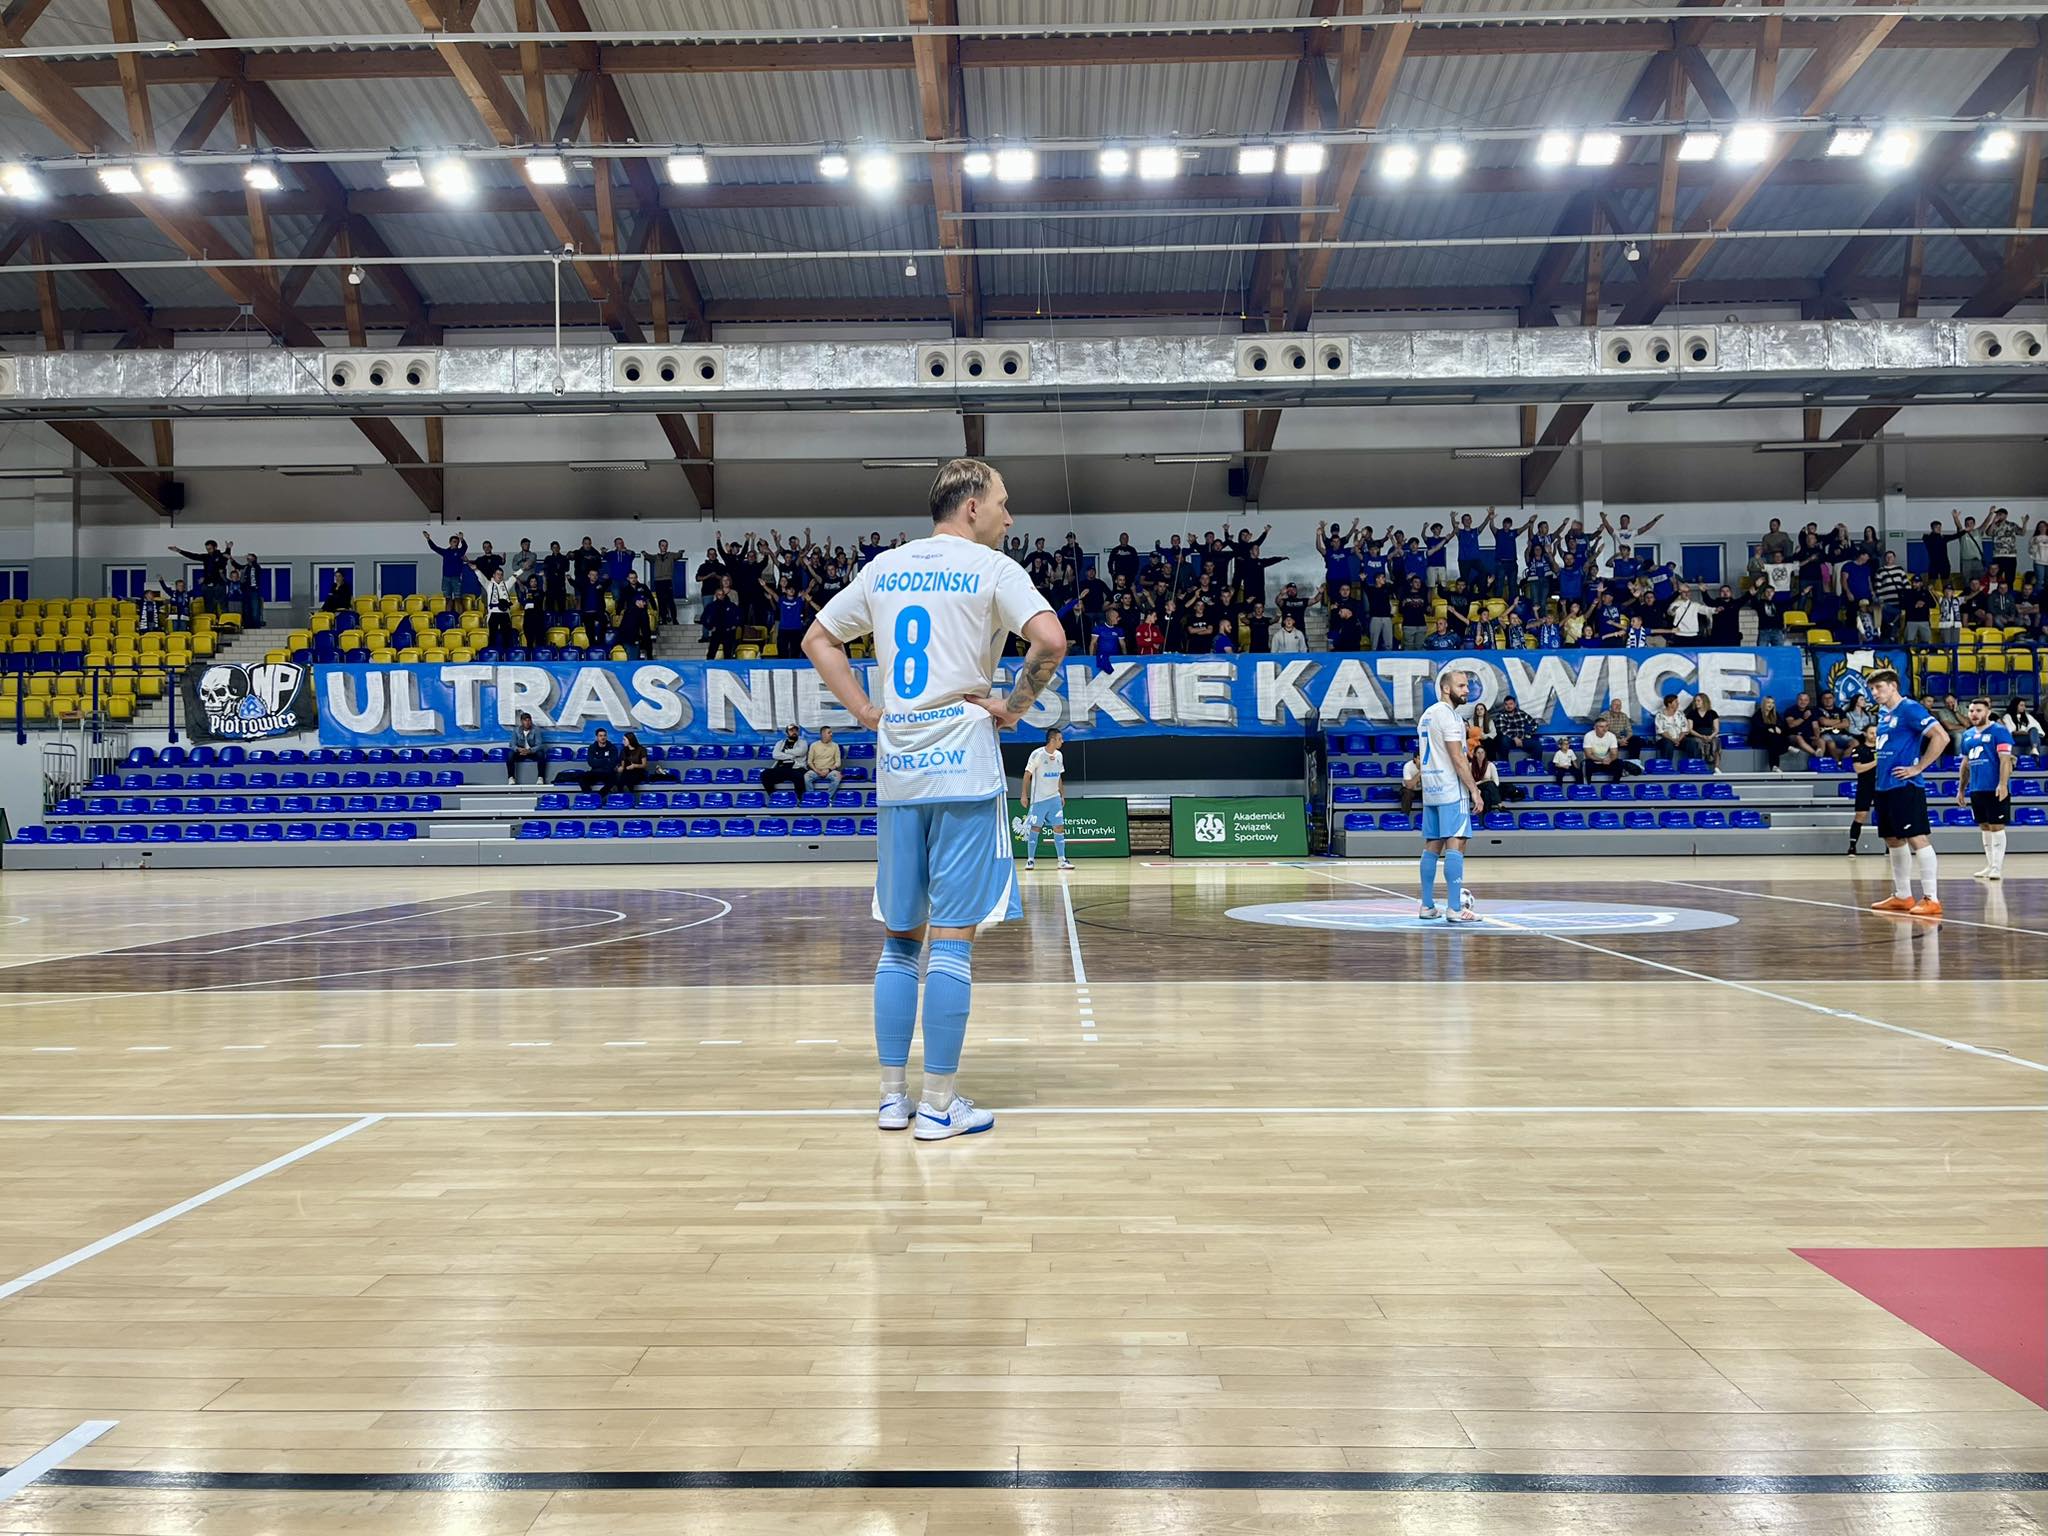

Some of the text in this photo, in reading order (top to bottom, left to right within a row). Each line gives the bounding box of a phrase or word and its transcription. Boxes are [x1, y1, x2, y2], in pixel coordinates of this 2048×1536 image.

[894, 605, 930, 699] 8
[325, 652, 1764, 733] ULTRAS NIESKIE KATOWICE
[210, 711, 297, 734] Piotrowice
[1421, 731, 1431, 765] 7
[1233, 811, 1286, 820] Akademicki
[1041, 826, 1071, 836] Spu
[1077, 826, 1116, 836] Turystyki
[1233, 822, 1272, 832] Związek
[1234, 833, 1279, 843] Sportowy
